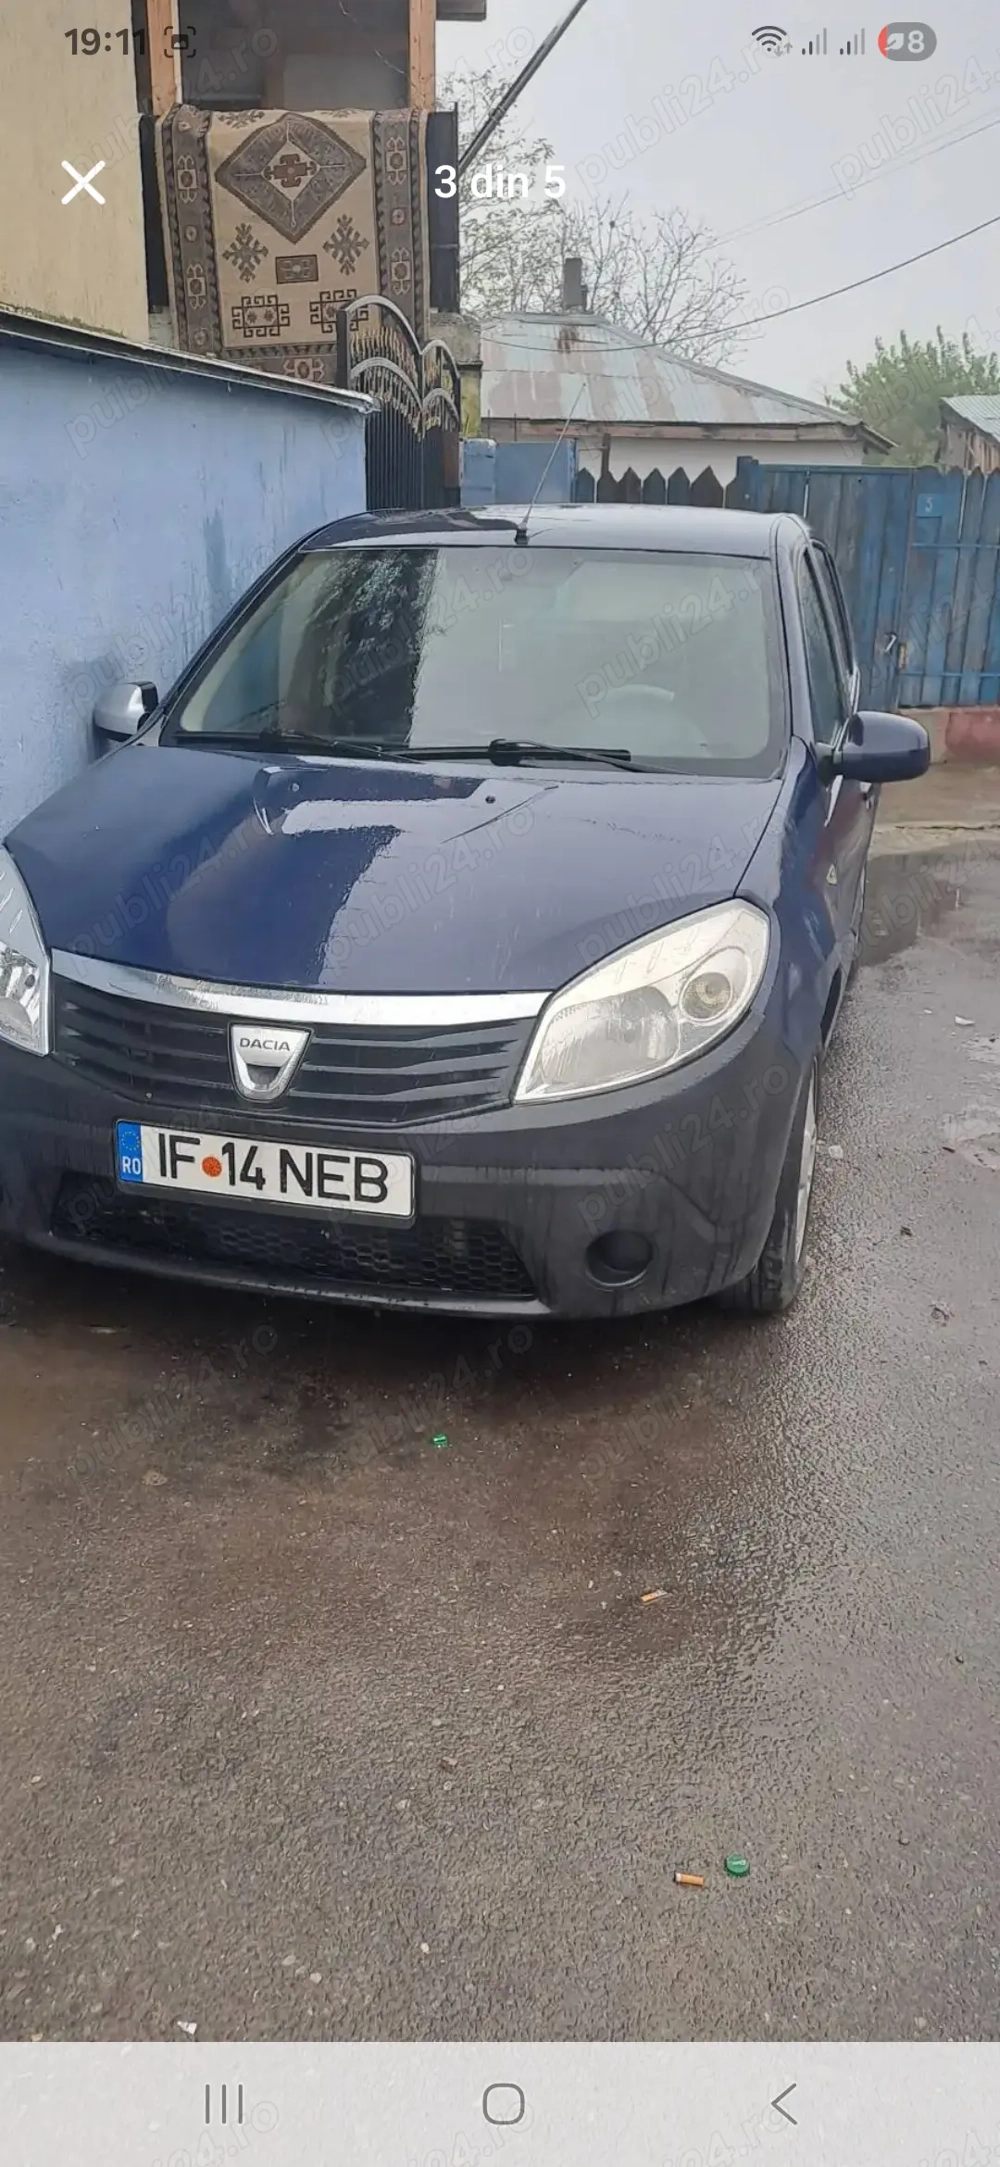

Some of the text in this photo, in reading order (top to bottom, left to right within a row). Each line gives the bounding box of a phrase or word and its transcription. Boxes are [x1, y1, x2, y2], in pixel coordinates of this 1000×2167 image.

[239, 1037, 290, 1051] DACIA
[122, 1156, 142, 1176] RO
[158, 1133, 388, 1204] IF 14 NEB
